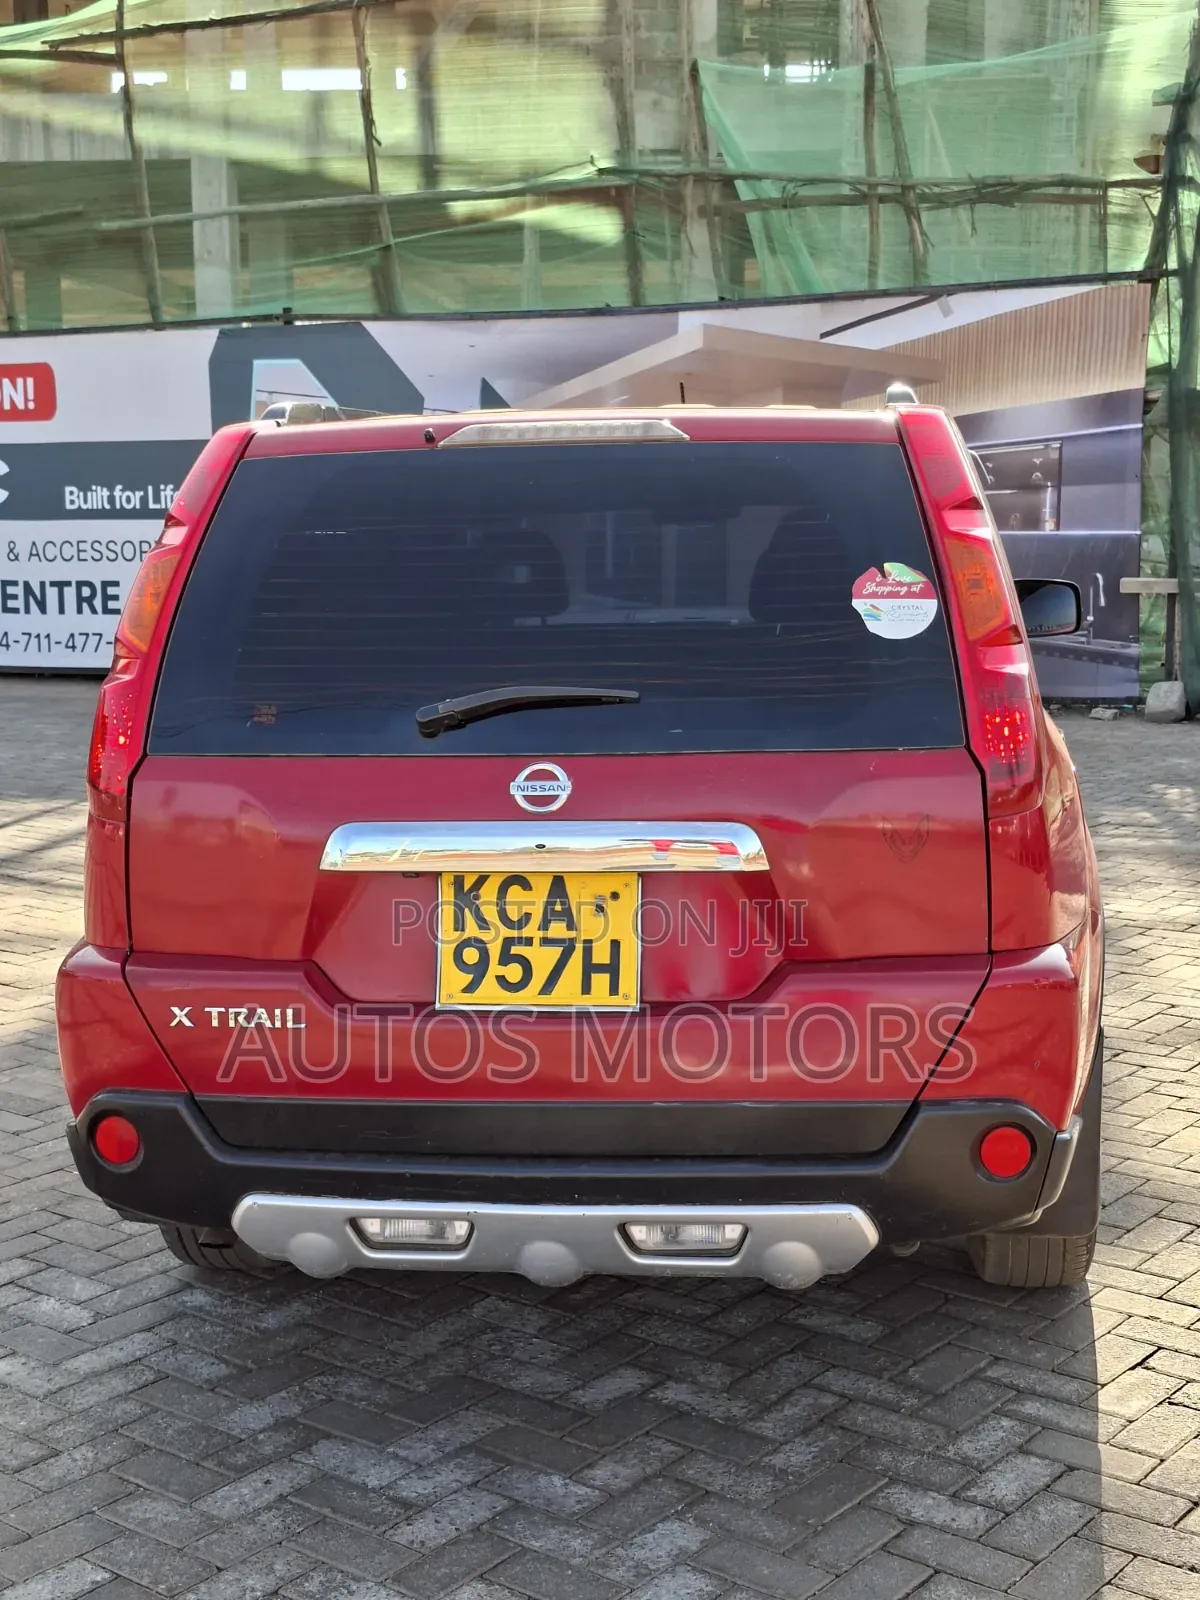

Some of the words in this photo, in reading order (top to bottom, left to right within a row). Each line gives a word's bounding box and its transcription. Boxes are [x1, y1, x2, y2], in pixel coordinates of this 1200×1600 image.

[0, 377, 35, 411] N!
[64, 486, 110, 511] Built
[113, 486, 143, 510] for
[6, 543, 20, 562] &
[27, 540, 157, 563] ACCESSOR
[862, 582, 908, 596] Shopping
[910, 583, 925, 594] at
[515, 782, 567, 794] NISSAN
[453, 874, 578, 933] KCA
[452, 936, 621, 996] 957H
[169, 1006, 195, 1028] X
[204, 1007, 307, 1029] TRAIL
